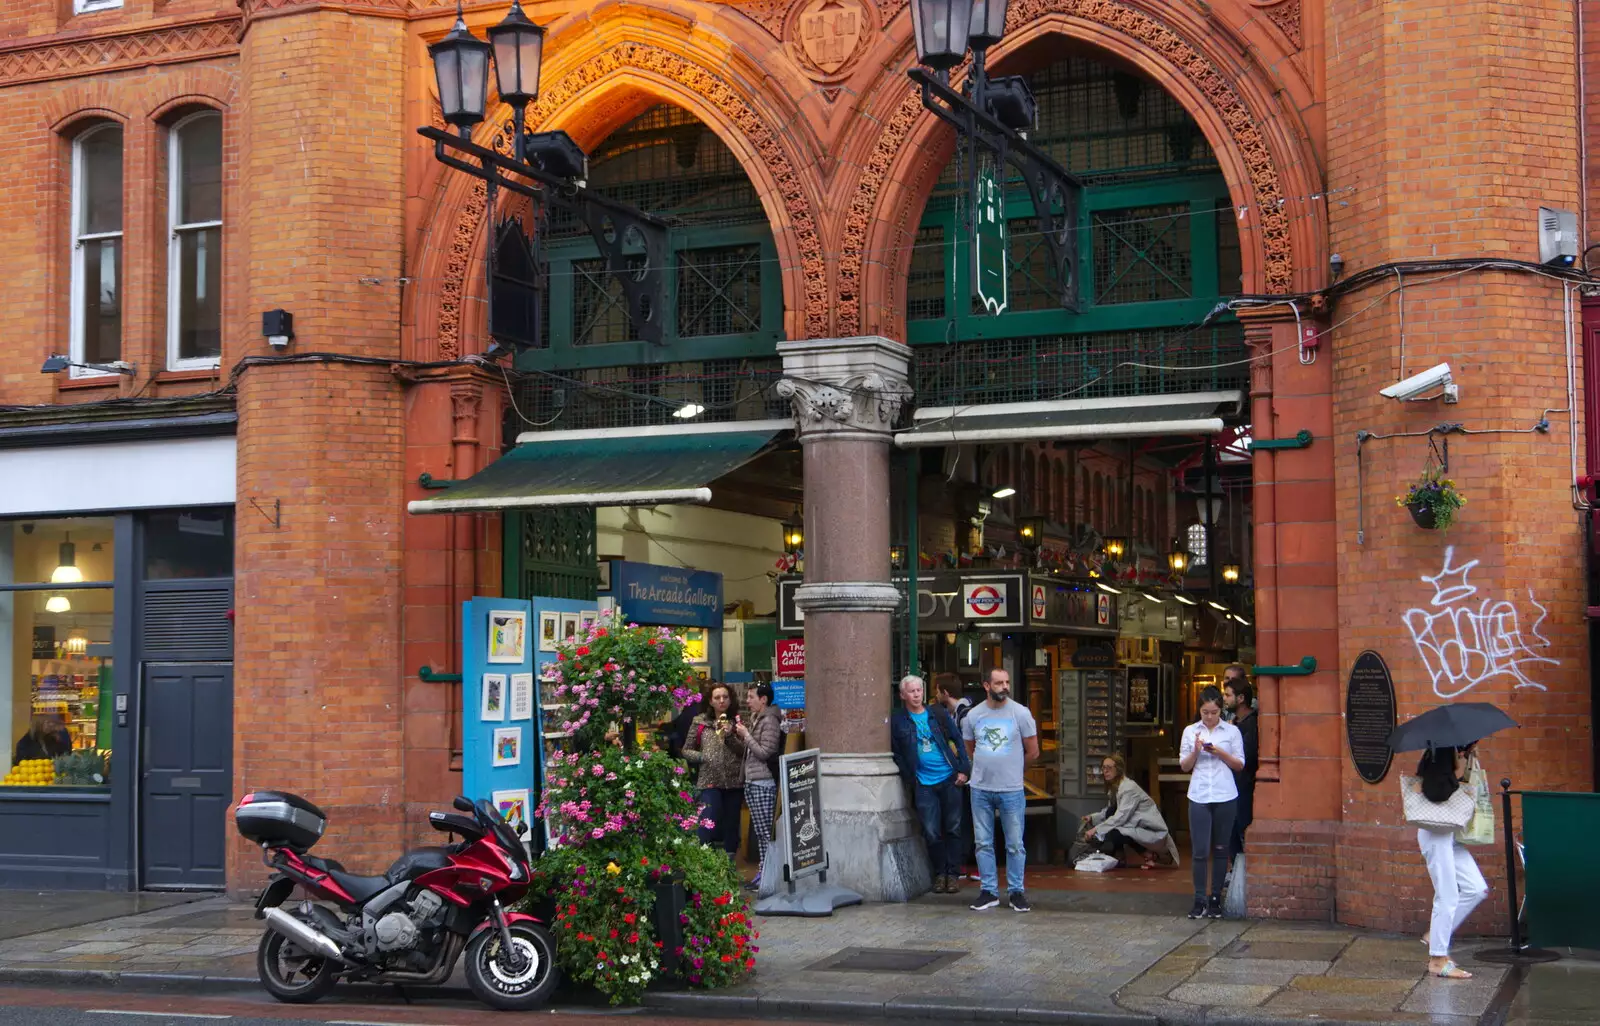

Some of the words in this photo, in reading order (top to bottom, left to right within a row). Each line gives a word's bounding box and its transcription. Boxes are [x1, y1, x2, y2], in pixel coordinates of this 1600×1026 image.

[628, 581, 647, 600] The
[648, 584, 683, 604] Arcade
[684, 587, 718, 613] Gallery
[788, 642, 805, 651] The
